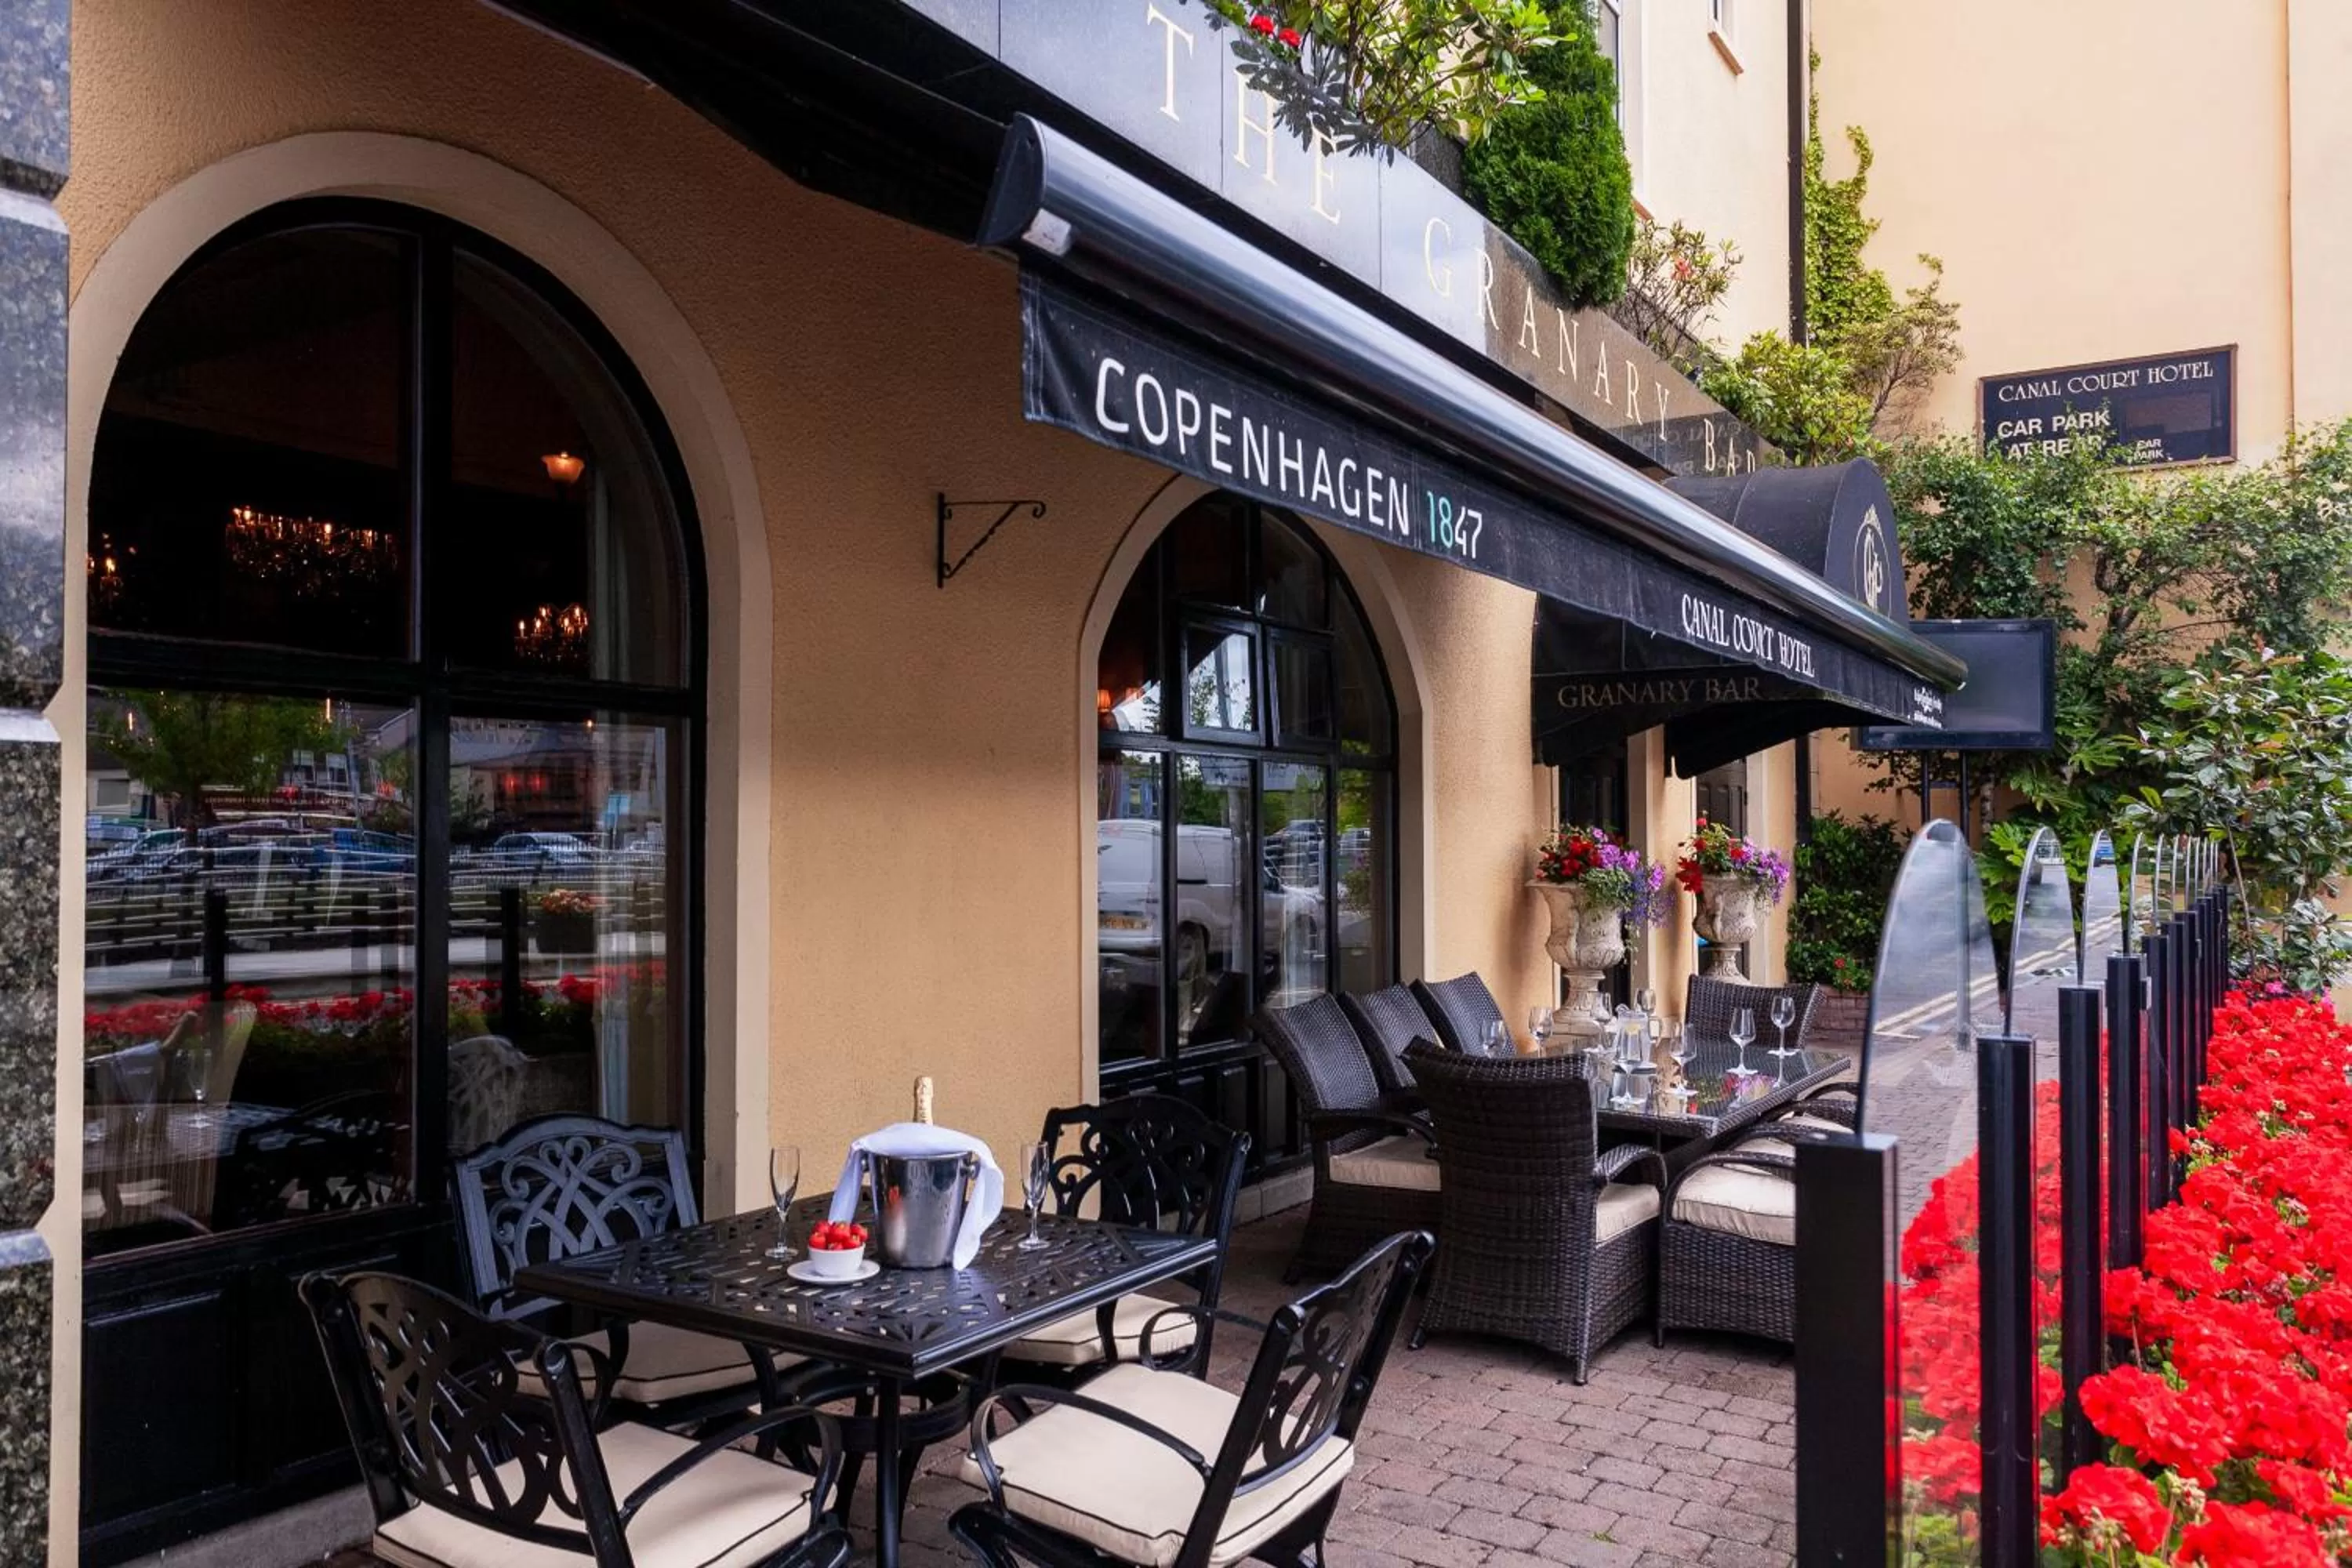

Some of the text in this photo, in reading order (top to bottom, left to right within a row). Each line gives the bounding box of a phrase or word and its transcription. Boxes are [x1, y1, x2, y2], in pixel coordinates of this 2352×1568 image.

[1147, 3, 1341, 226] THE
[1425, 217, 1668, 441] GRANARY
[1998, 361, 2214, 402] CANAL COURT HOTEL
[1998, 410, 2111, 438] CAR PARK
[1096, 358, 1483, 559] COPENHAGEN 1847
[2008, 441, 2032, 462] AT
[2136, 438, 2161, 449] CAR
[1682, 593, 1730, 647] CANAL
[1777, 631, 1815, 677] HOTEL
[1557, 677, 1763, 707] GRANARY BAR
